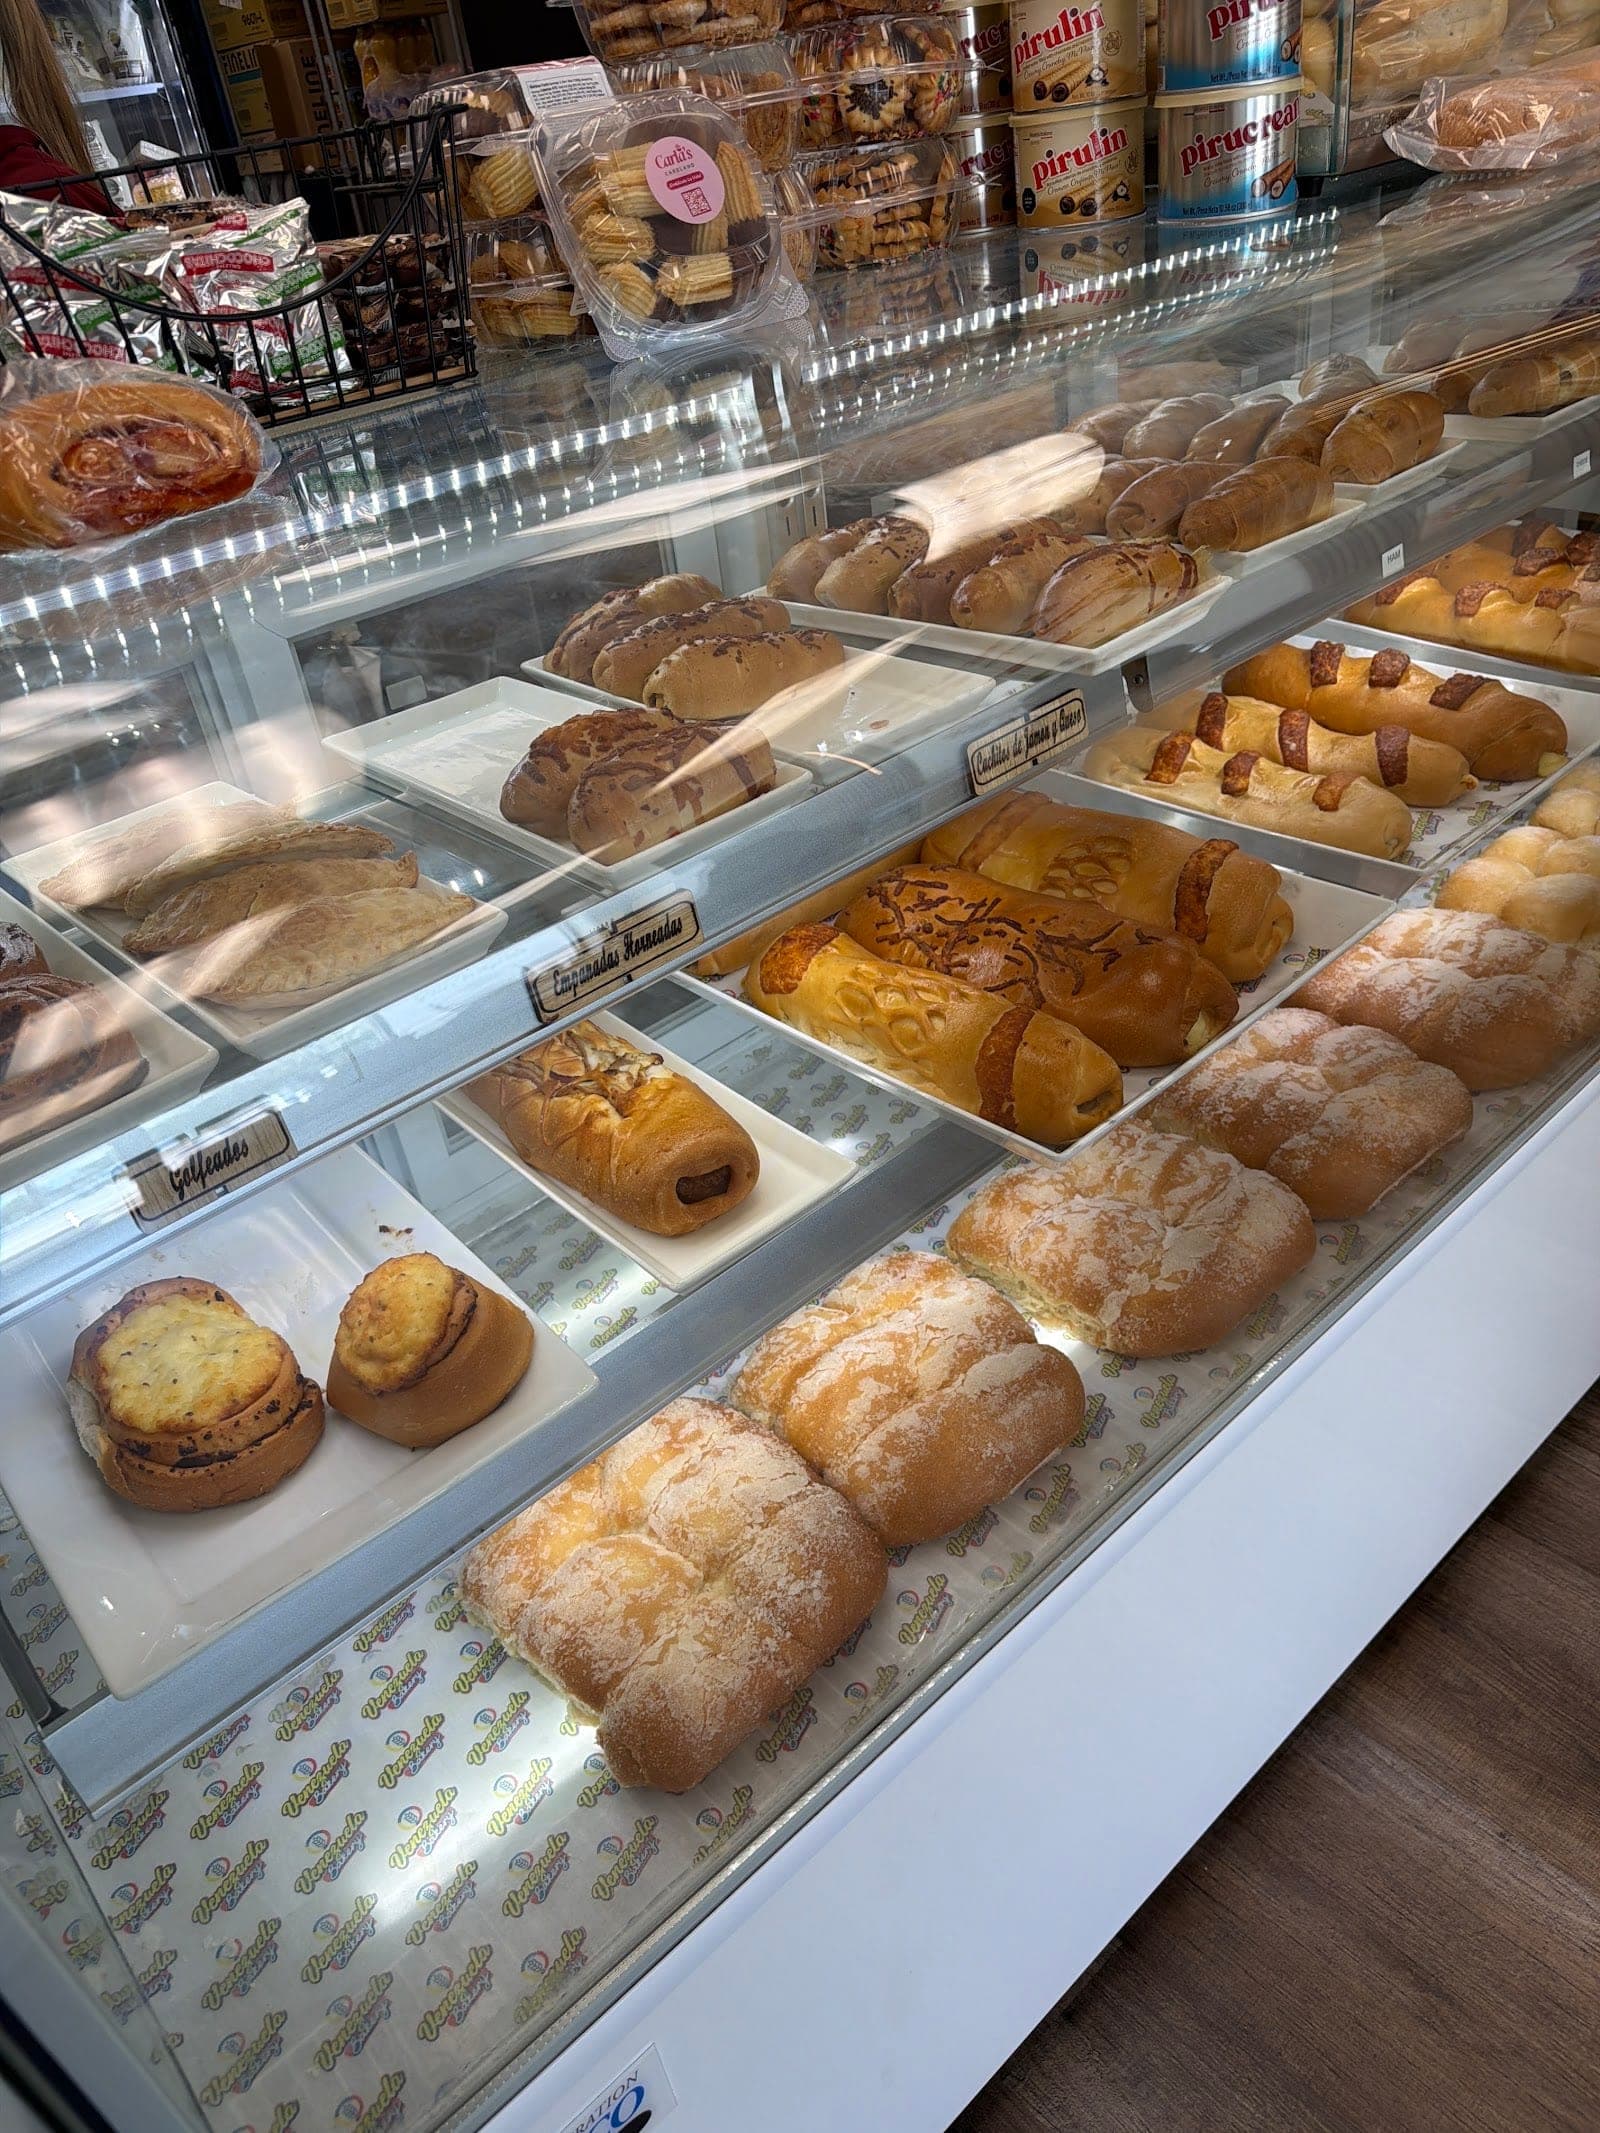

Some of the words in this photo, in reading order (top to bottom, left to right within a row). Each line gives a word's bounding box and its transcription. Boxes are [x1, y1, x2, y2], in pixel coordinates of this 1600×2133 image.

[1014, 8, 1105, 76] pirulin
[655, 146, 693, 169] Carla's
[1032, 127, 1129, 191] pirulin
[180, 253, 273, 274] CHOCOCHITAS
[553, 946, 620, 997] Empanadas
[623, 912, 683, 962] Horneadas
[169, 1137, 249, 1201] Golfeados
[899, 1573, 949, 1645] Venezuela
[276, 1669, 344, 1742] Venezuela
[361, 1649, 428, 1720] Venezuela
[755, 1686, 814, 1763] Venezuela
[378, 1712, 445, 1789] Venezuela
[467, 1690, 531, 1766] Venezuela
[189, 1761, 265, 1841] Venezuela
[281, 1739, 352, 1818] Venezuela
[486, 1756, 553, 1837] Venezuela
[91, 1789, 170, 1870] Venezuela
[294, 1810, 368, 1895] Venezuela
[389, 1786, 458, 1870] Venezuela
[591, 1814, 658, 1901] Venezuela
[110, 1862, 177, 1931] enezuela
[192, 1838, 270, 1925] Venezuela
[405, 1860, 479, 1947] Venezuela
[501, 1831, 570, 1918] Venezuela
[201, 1917, 282, 2011] Venezuela
[301, 1893, 378, 1985] Venezuela
[313, 1970, 394, 2072] Venezuela
[416, 1943, 494, 2042] Venezuela
